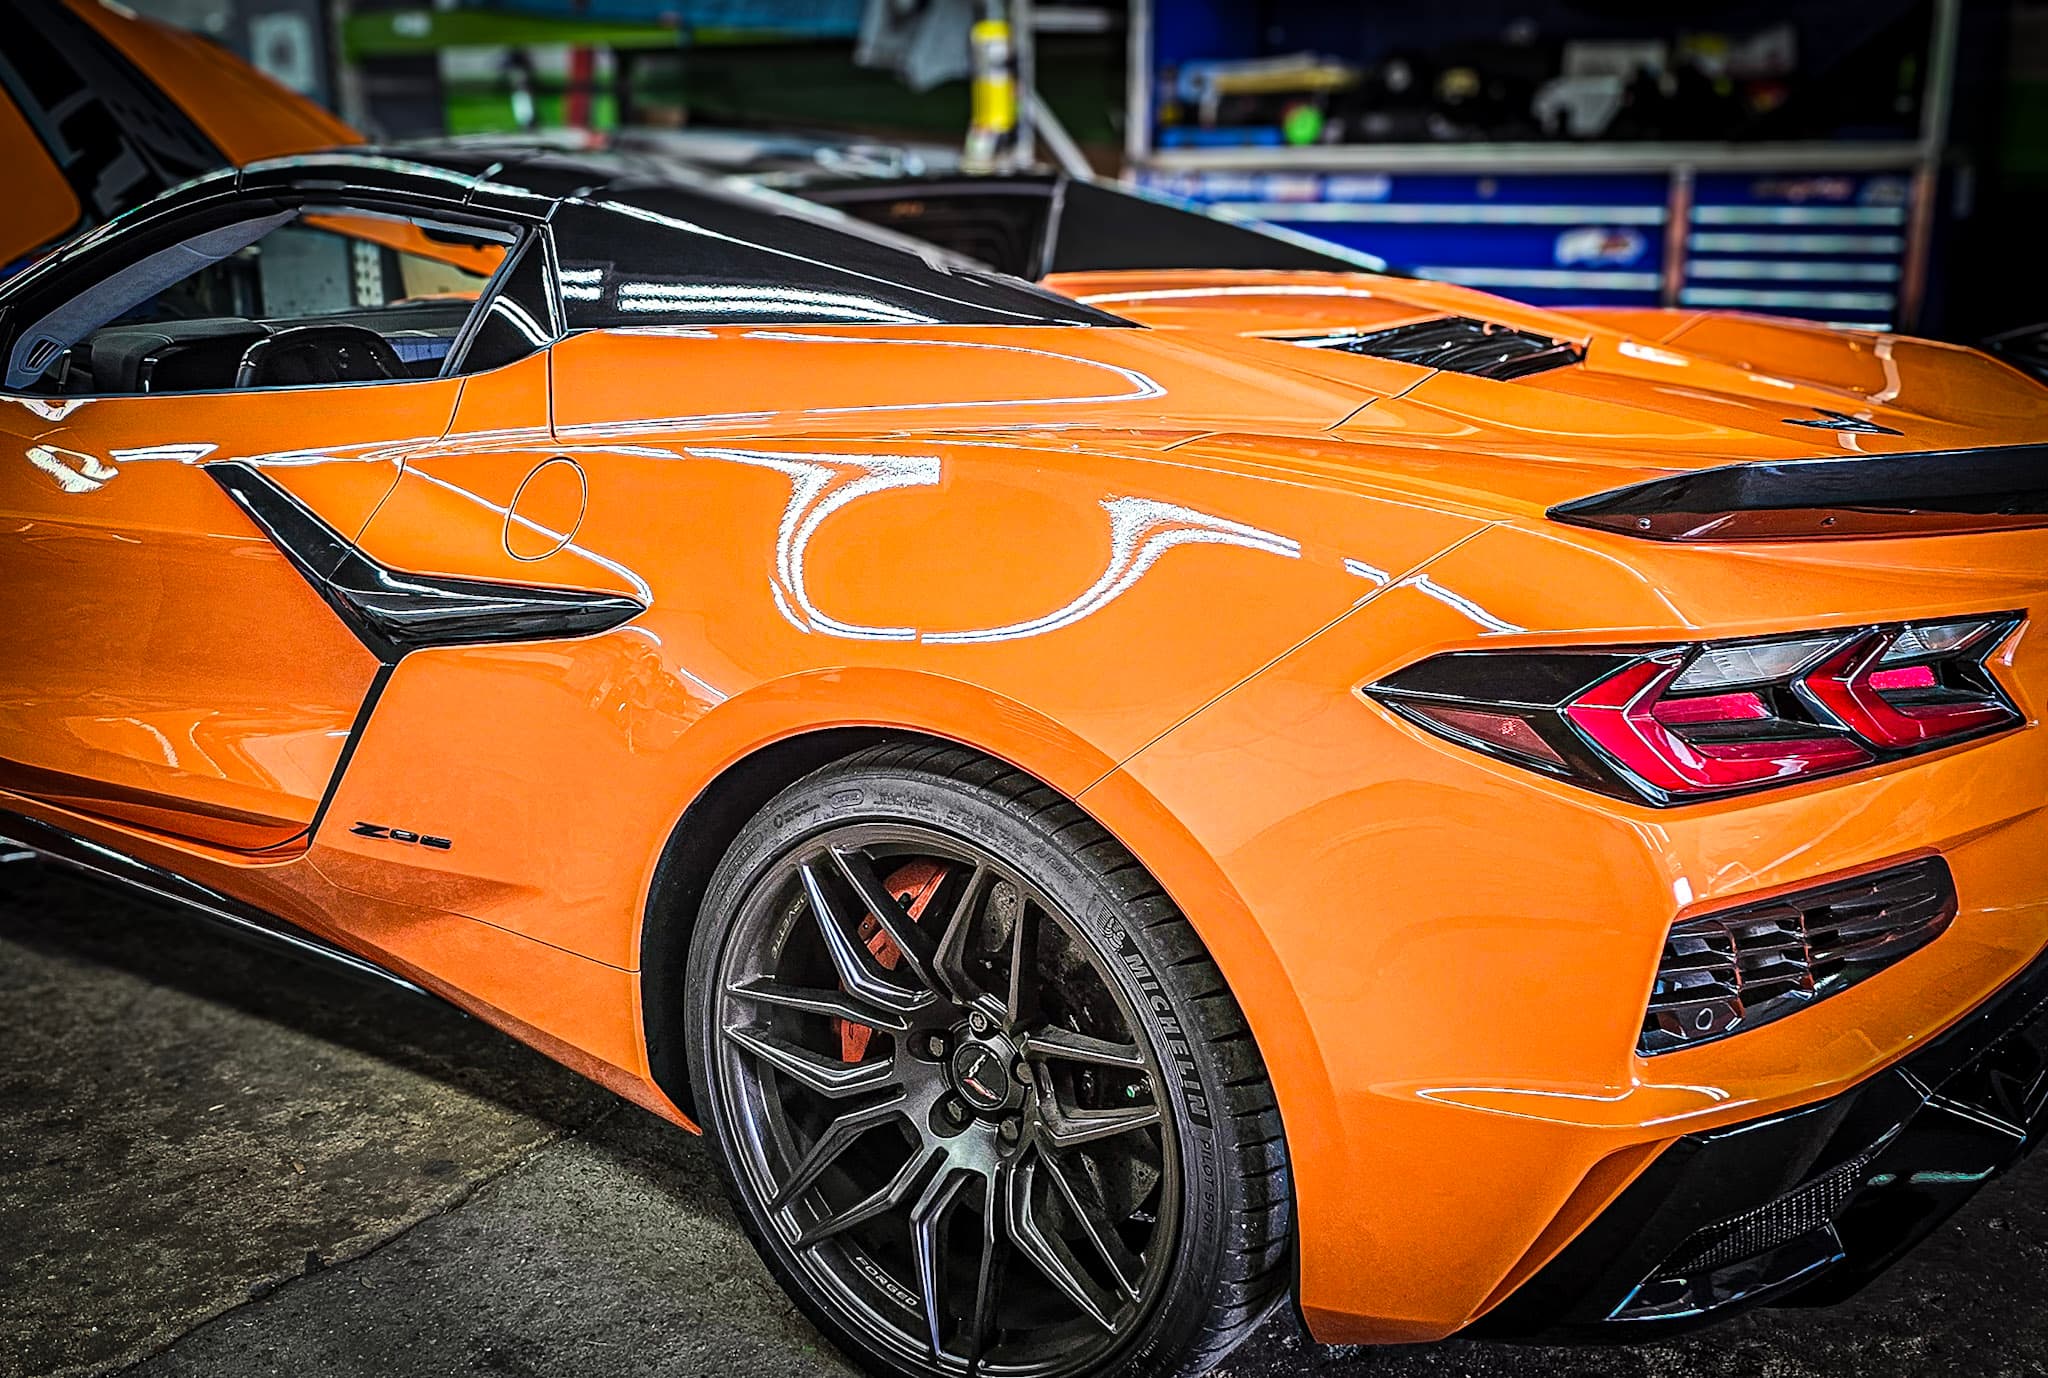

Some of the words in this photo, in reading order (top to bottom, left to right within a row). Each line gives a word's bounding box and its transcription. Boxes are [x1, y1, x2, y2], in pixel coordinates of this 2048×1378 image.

[1124, 952, 1209, 1124] MICHELIN
[1200, 1138, 1215, 1187] PILOT
[855, 1256, 918, 1307] FORGED
